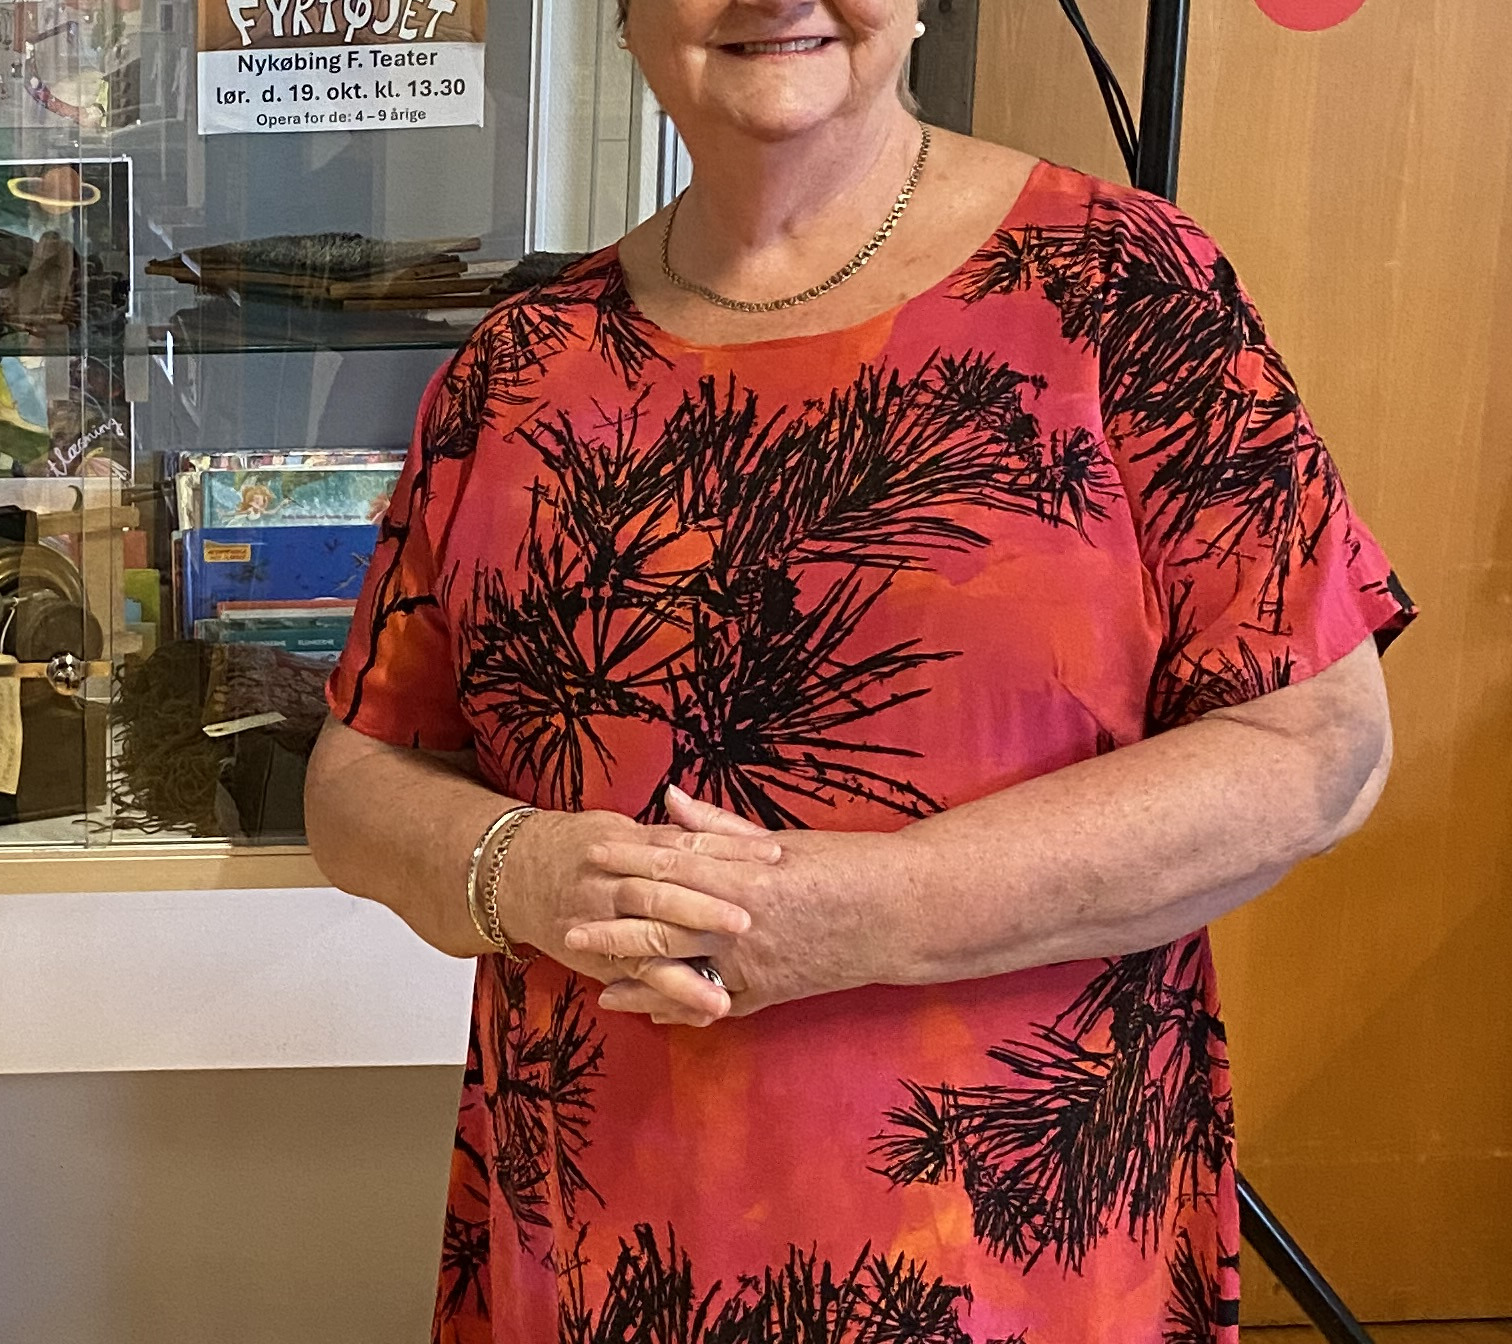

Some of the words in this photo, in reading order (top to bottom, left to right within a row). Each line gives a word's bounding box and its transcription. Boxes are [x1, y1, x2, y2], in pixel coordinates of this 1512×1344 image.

[238, 52, 341, 76] Nykøbing
[348, 50, 363, 68] F.
[369, 48, 438, 68] Teater
[216, 87, 251, 104] lør.
[261, 84, 282, 103] d.
[289, 84, 320, 102] 19.
[326, 82, 369, 101] okt.
[375, 80, 401, 98] kl.
[407, 78, 466, 98] 13.30
[256, 113, 302, 128] Opera
[304, 109, 325, 124] for
[328, 109, 352, 124] de:
[355, 109, 365, 122] 4
[377, 109, 387, 122] 9
[389, 107, 427, 123] årige
